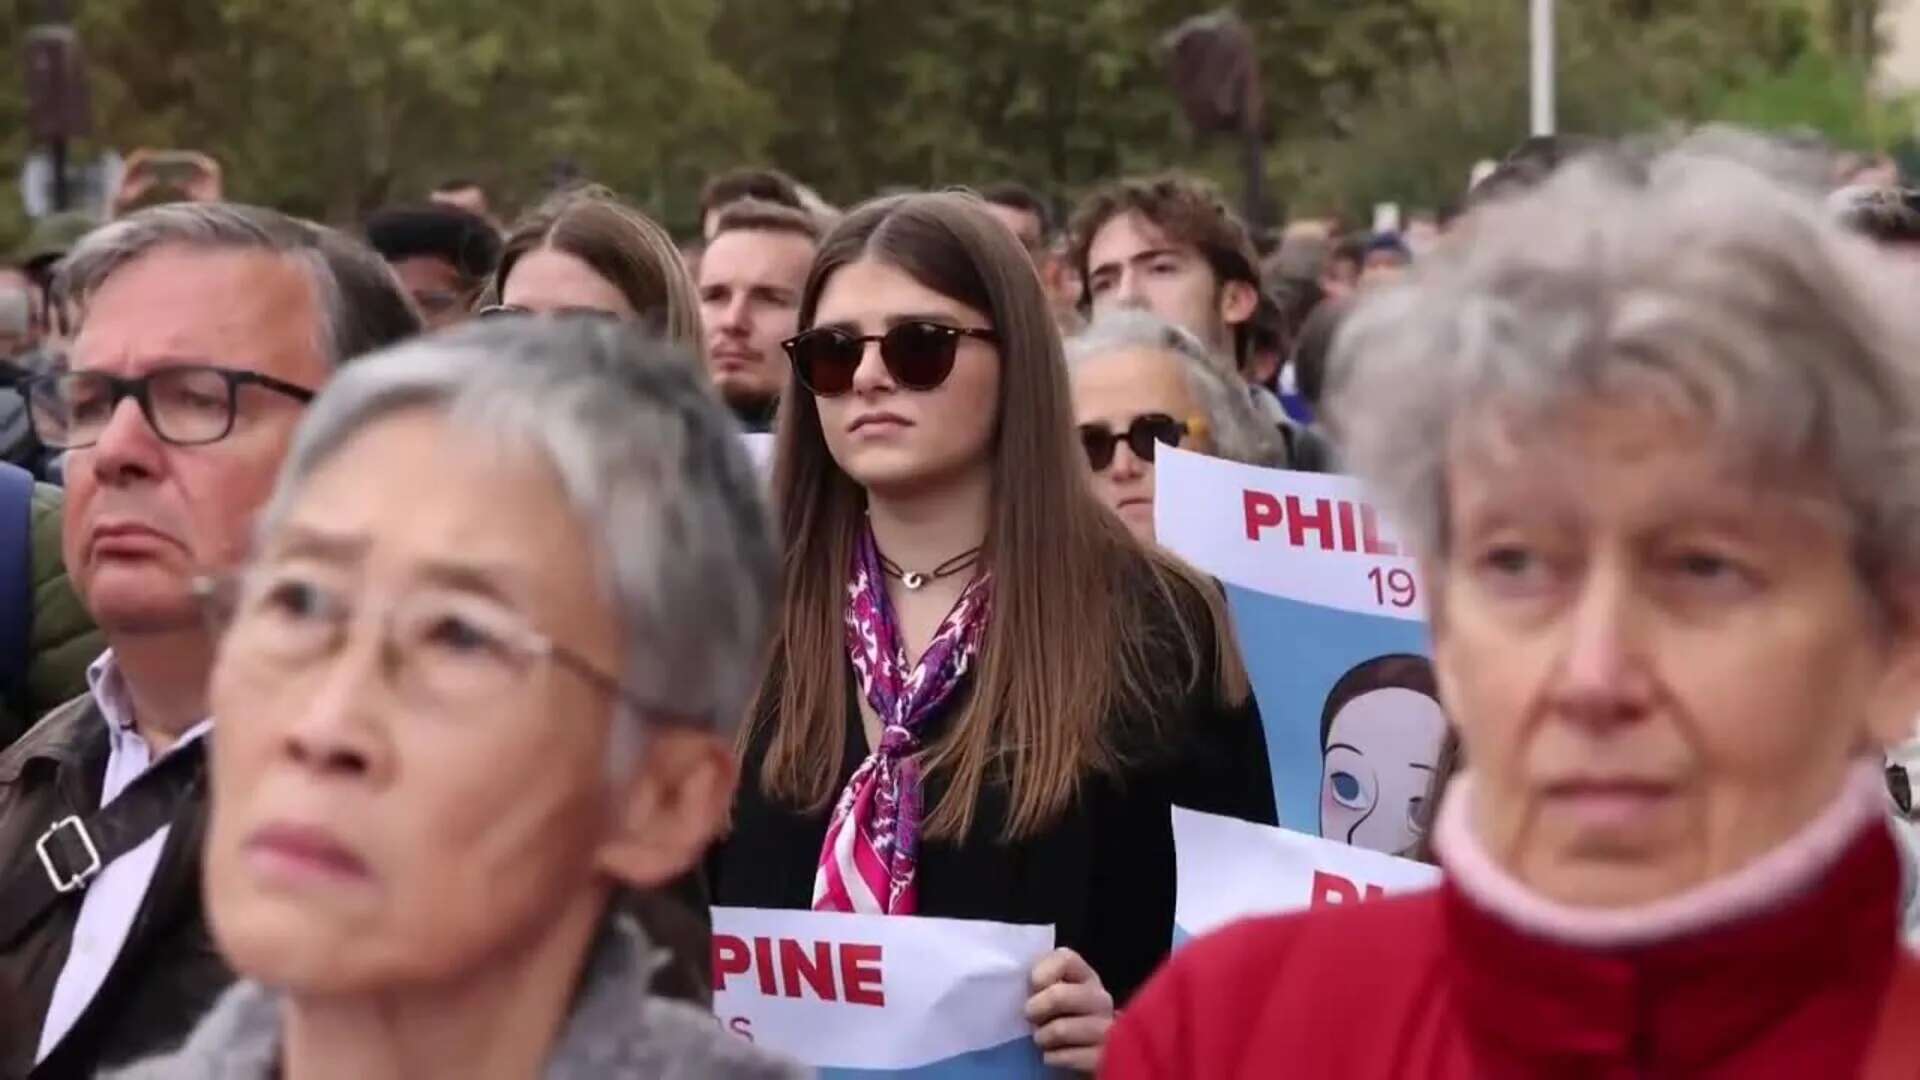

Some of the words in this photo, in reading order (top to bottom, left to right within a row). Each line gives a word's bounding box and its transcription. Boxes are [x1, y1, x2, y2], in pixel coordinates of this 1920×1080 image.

[1243, 490, 1416, 558] PHIL
[1367, 566, 1417, 607] 19
[1311, 870, 1384, 912] P
[712, 934, 885, 1007] PINE
